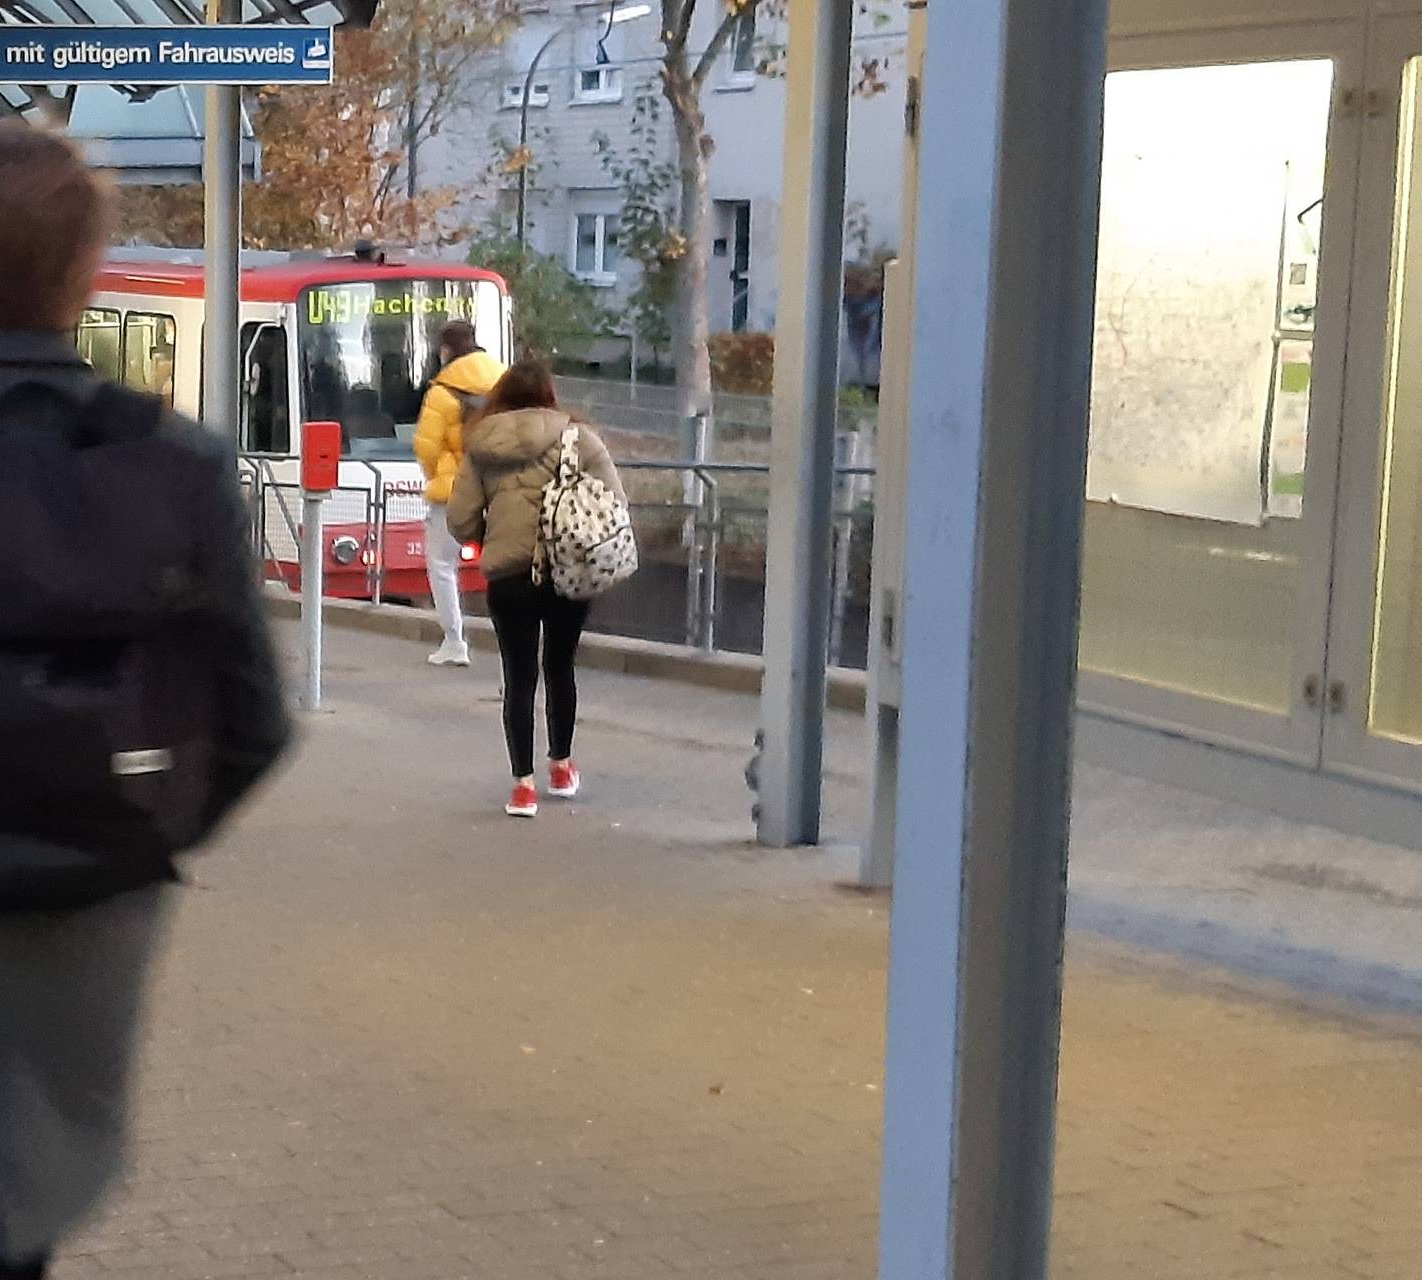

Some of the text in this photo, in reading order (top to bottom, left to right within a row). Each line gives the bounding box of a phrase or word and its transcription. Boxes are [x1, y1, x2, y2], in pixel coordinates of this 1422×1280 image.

[6, 41, 45, 63] mit
[53, 41, 151, 68] gültigem
[159, 41, 295, 63] Fahrausweis
